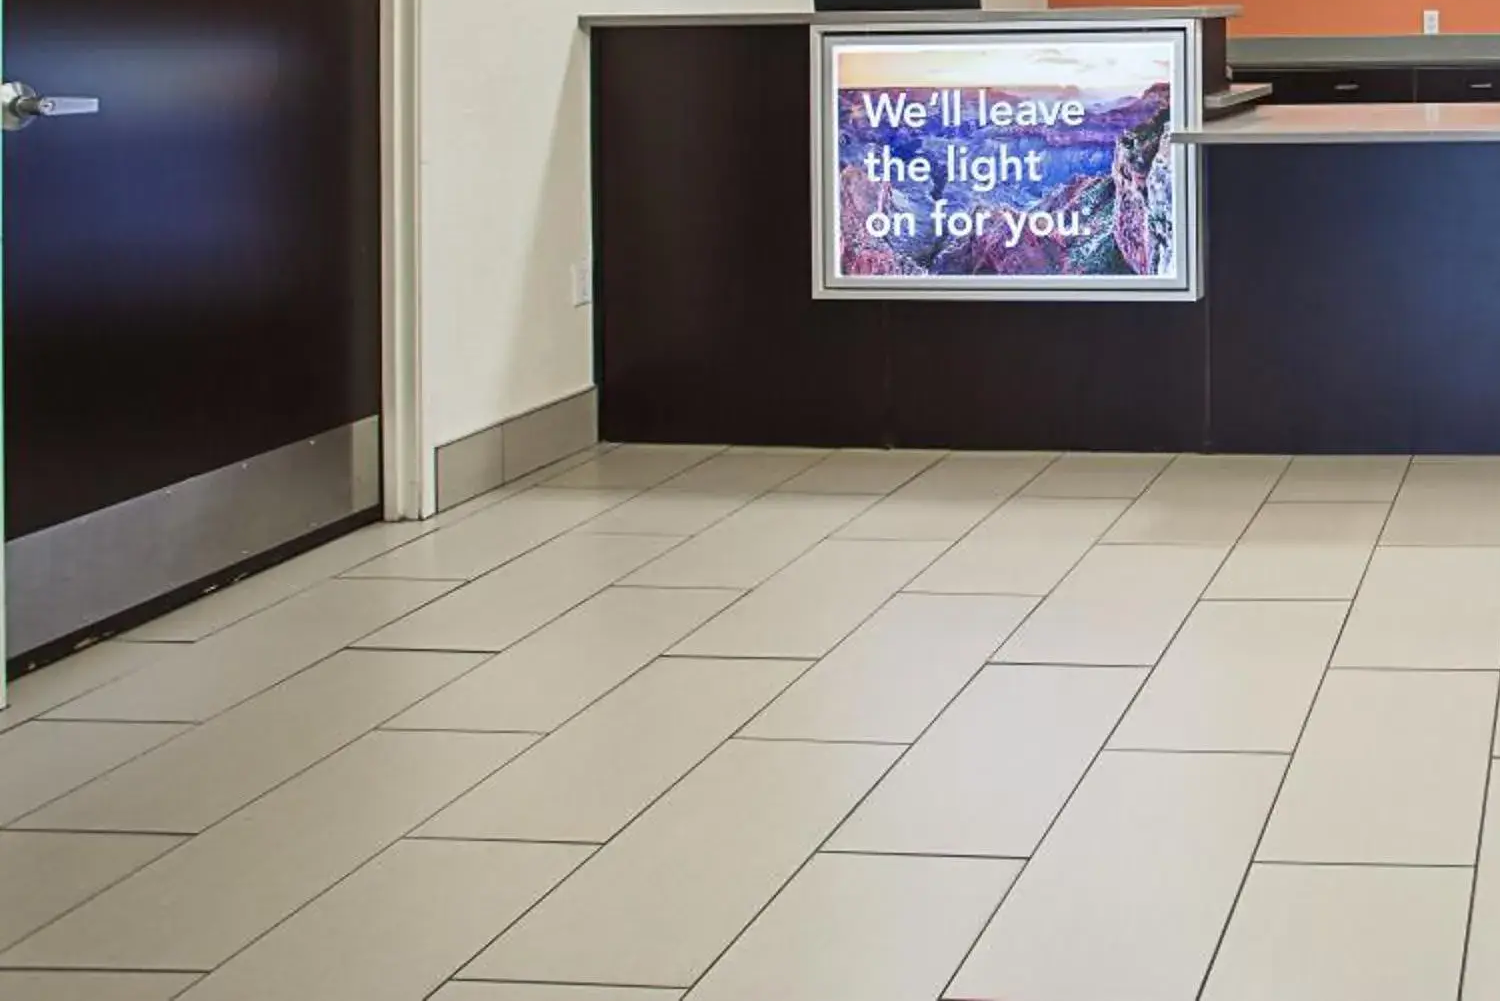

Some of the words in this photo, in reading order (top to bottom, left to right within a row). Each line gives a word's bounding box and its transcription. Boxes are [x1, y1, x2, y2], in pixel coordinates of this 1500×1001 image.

[863, 89, 961, 128] We'll
[979, 89, 1085, 127] leave
[863, 145, 931, 183] the
[947, 144, 1043, 192] light
[865, 211, 916, 238] on
[931, 198, 991, 237] for
[1004, 210, 1092, 248] you.
